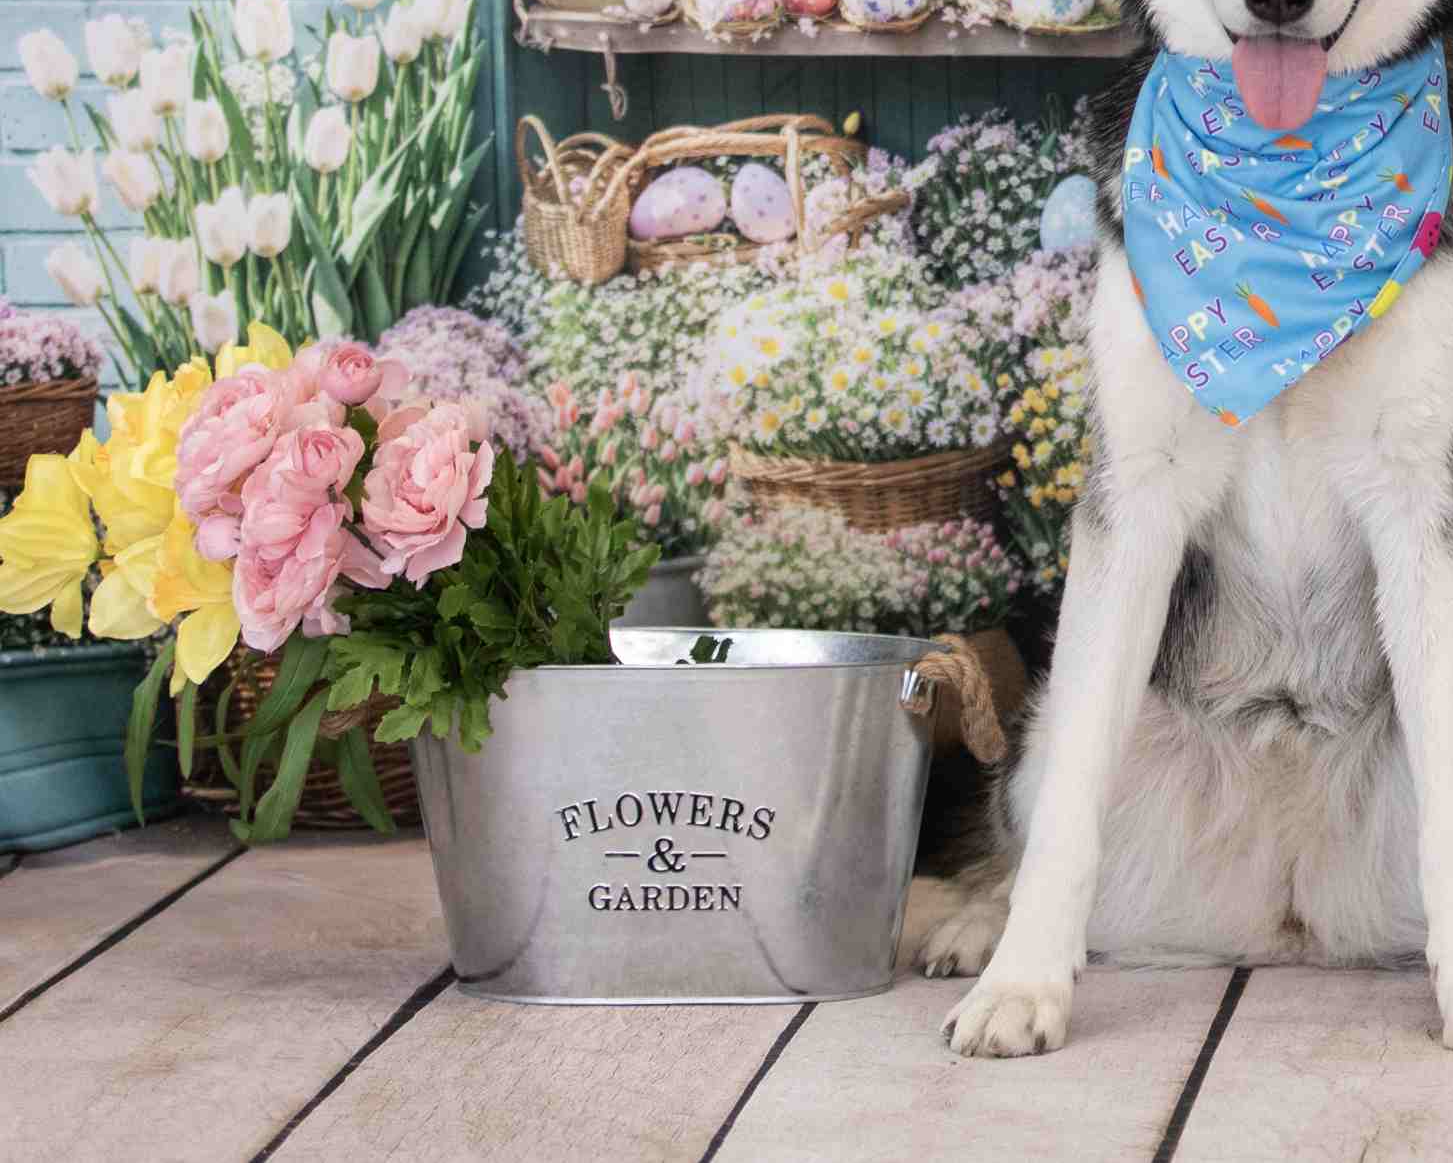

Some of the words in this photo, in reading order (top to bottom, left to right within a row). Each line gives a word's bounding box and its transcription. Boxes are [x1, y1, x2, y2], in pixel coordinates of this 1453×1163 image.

[1309, 202, 1413, 292] ESTER
[1159, 295, 1229, 365] APPY
[1185, 324, 1266, 391] STER
[555, 792, 776, 842] FLOWERS
[647, 837, 686, 873] &
[588, 885, 742, 911] GARDEN
